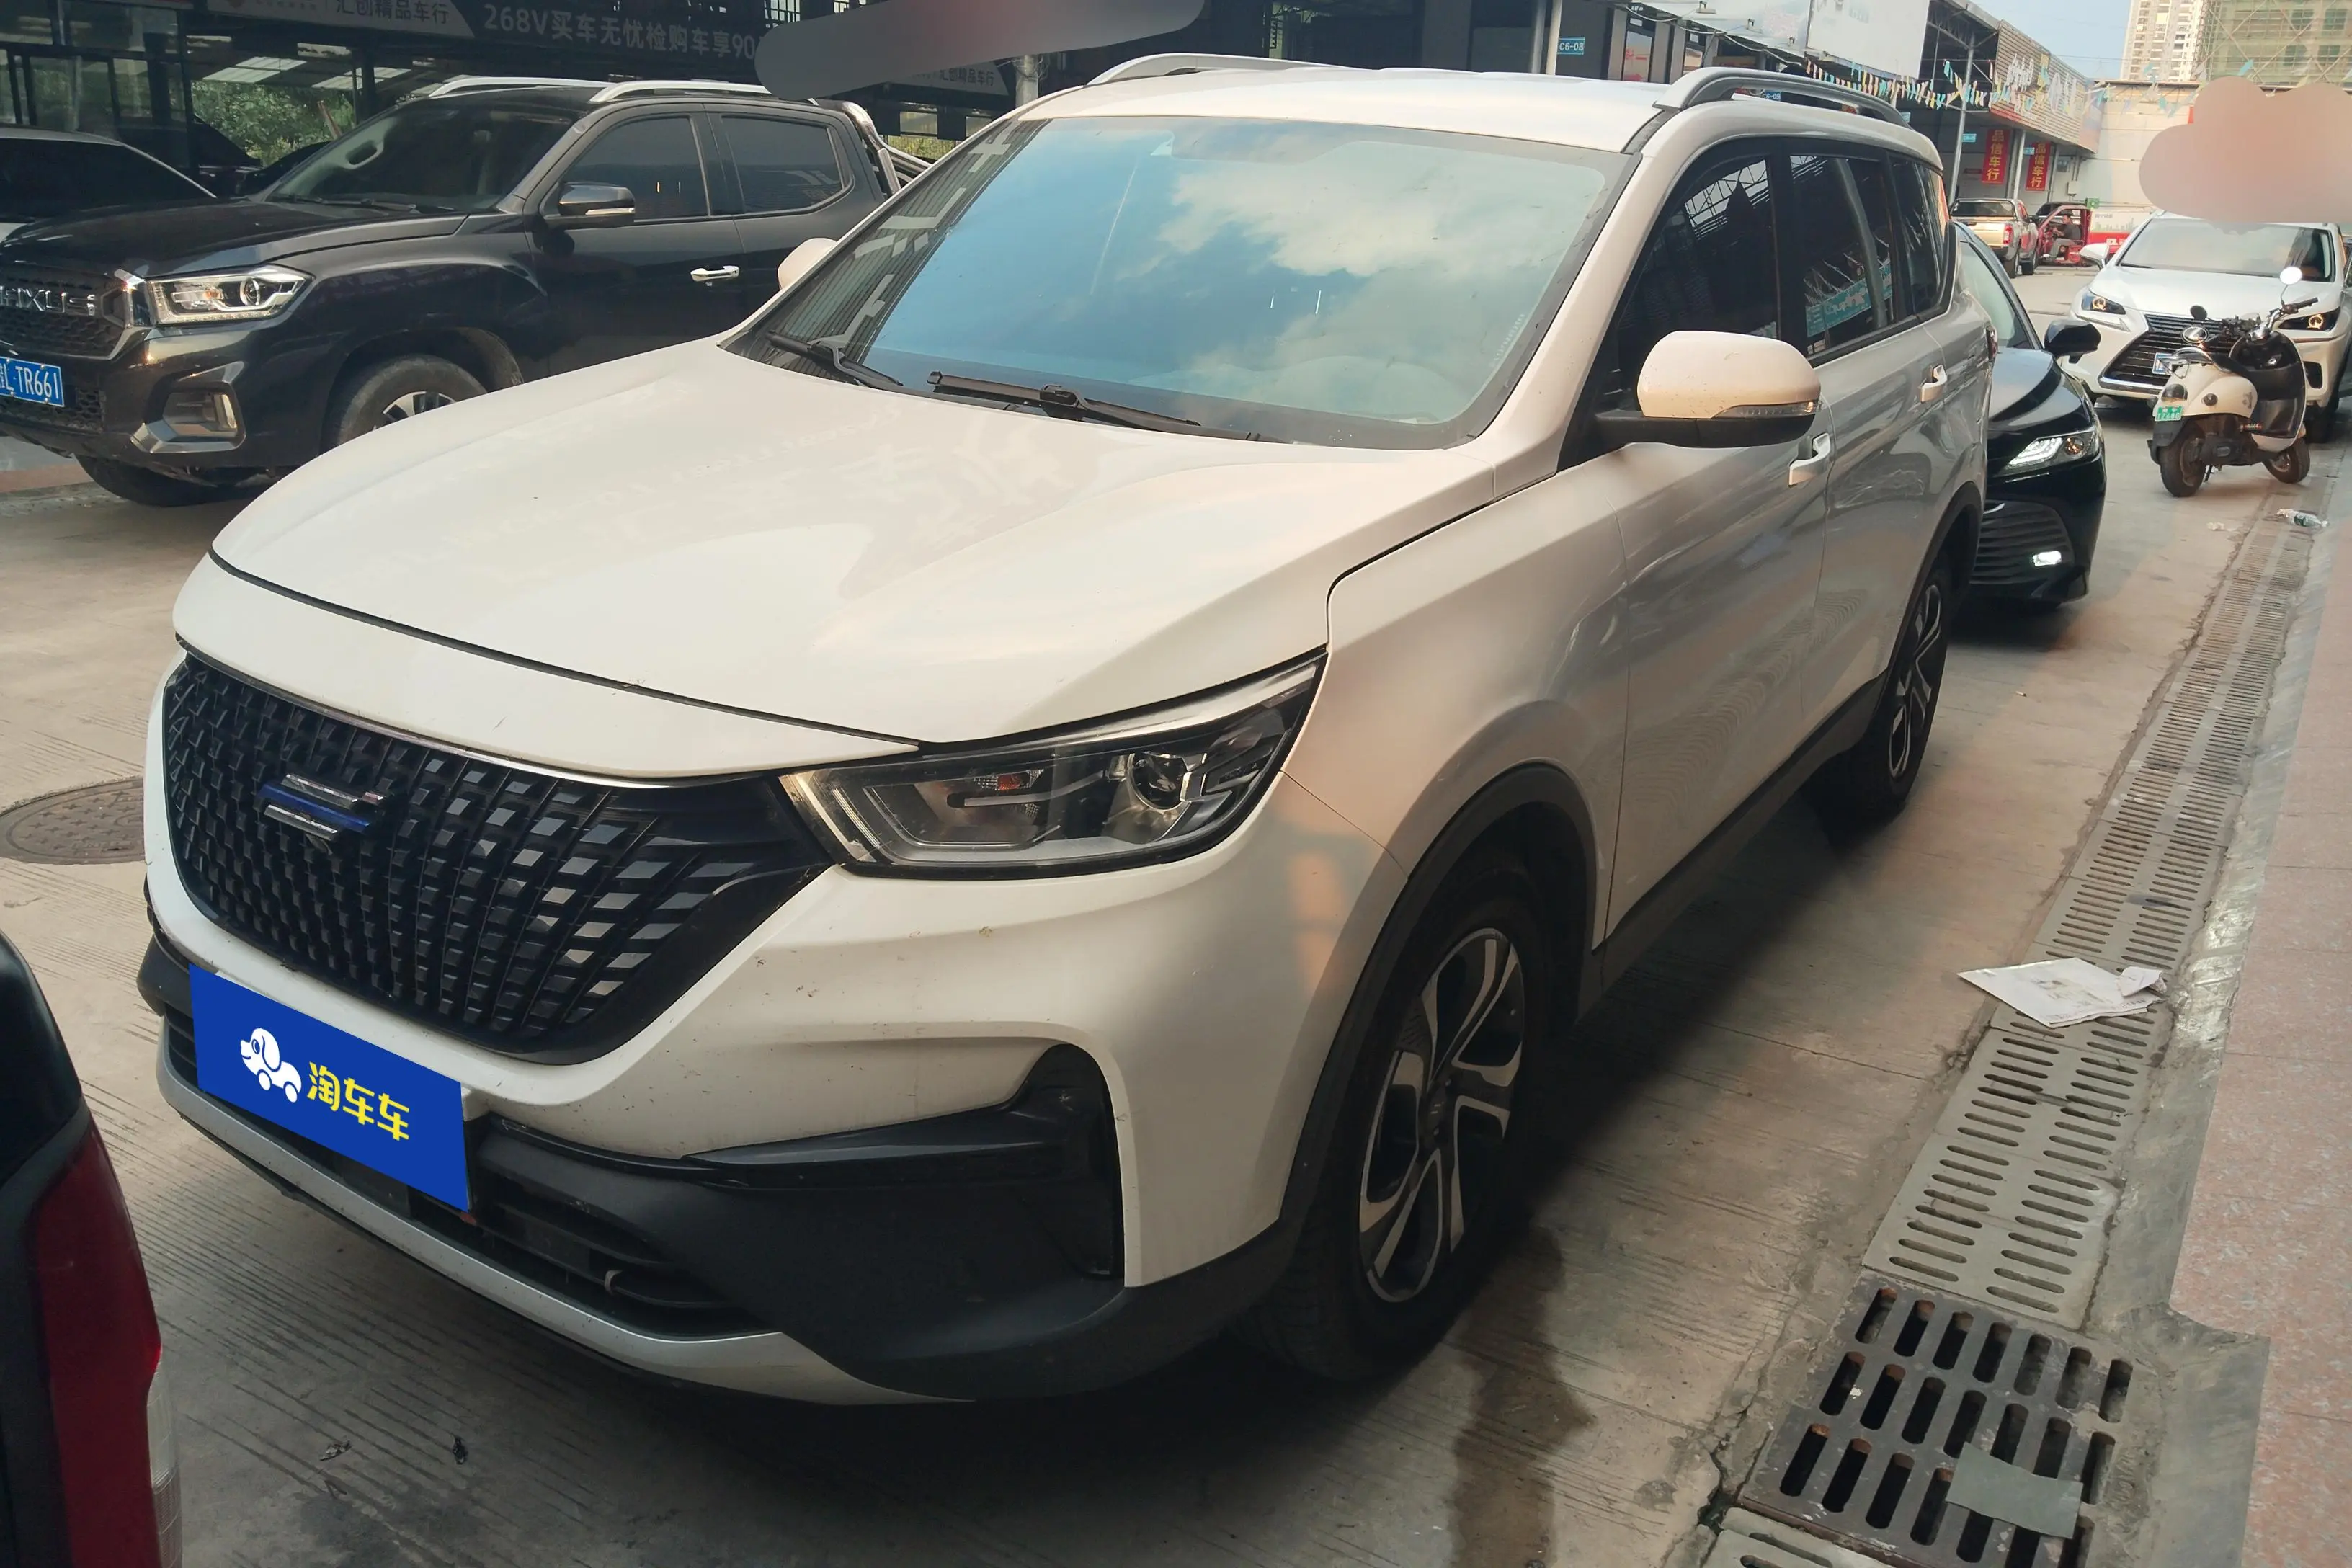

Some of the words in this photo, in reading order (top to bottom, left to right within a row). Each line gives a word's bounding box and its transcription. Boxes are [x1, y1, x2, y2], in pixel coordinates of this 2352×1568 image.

[484, 4, 764, 60] 268V买车无忧检购车享90
[1559, 42, 1584, 51] C6-08
[1987, 129, 2004, 180] 品信车行
[2031, 143, 2046, 187] 品信车行
